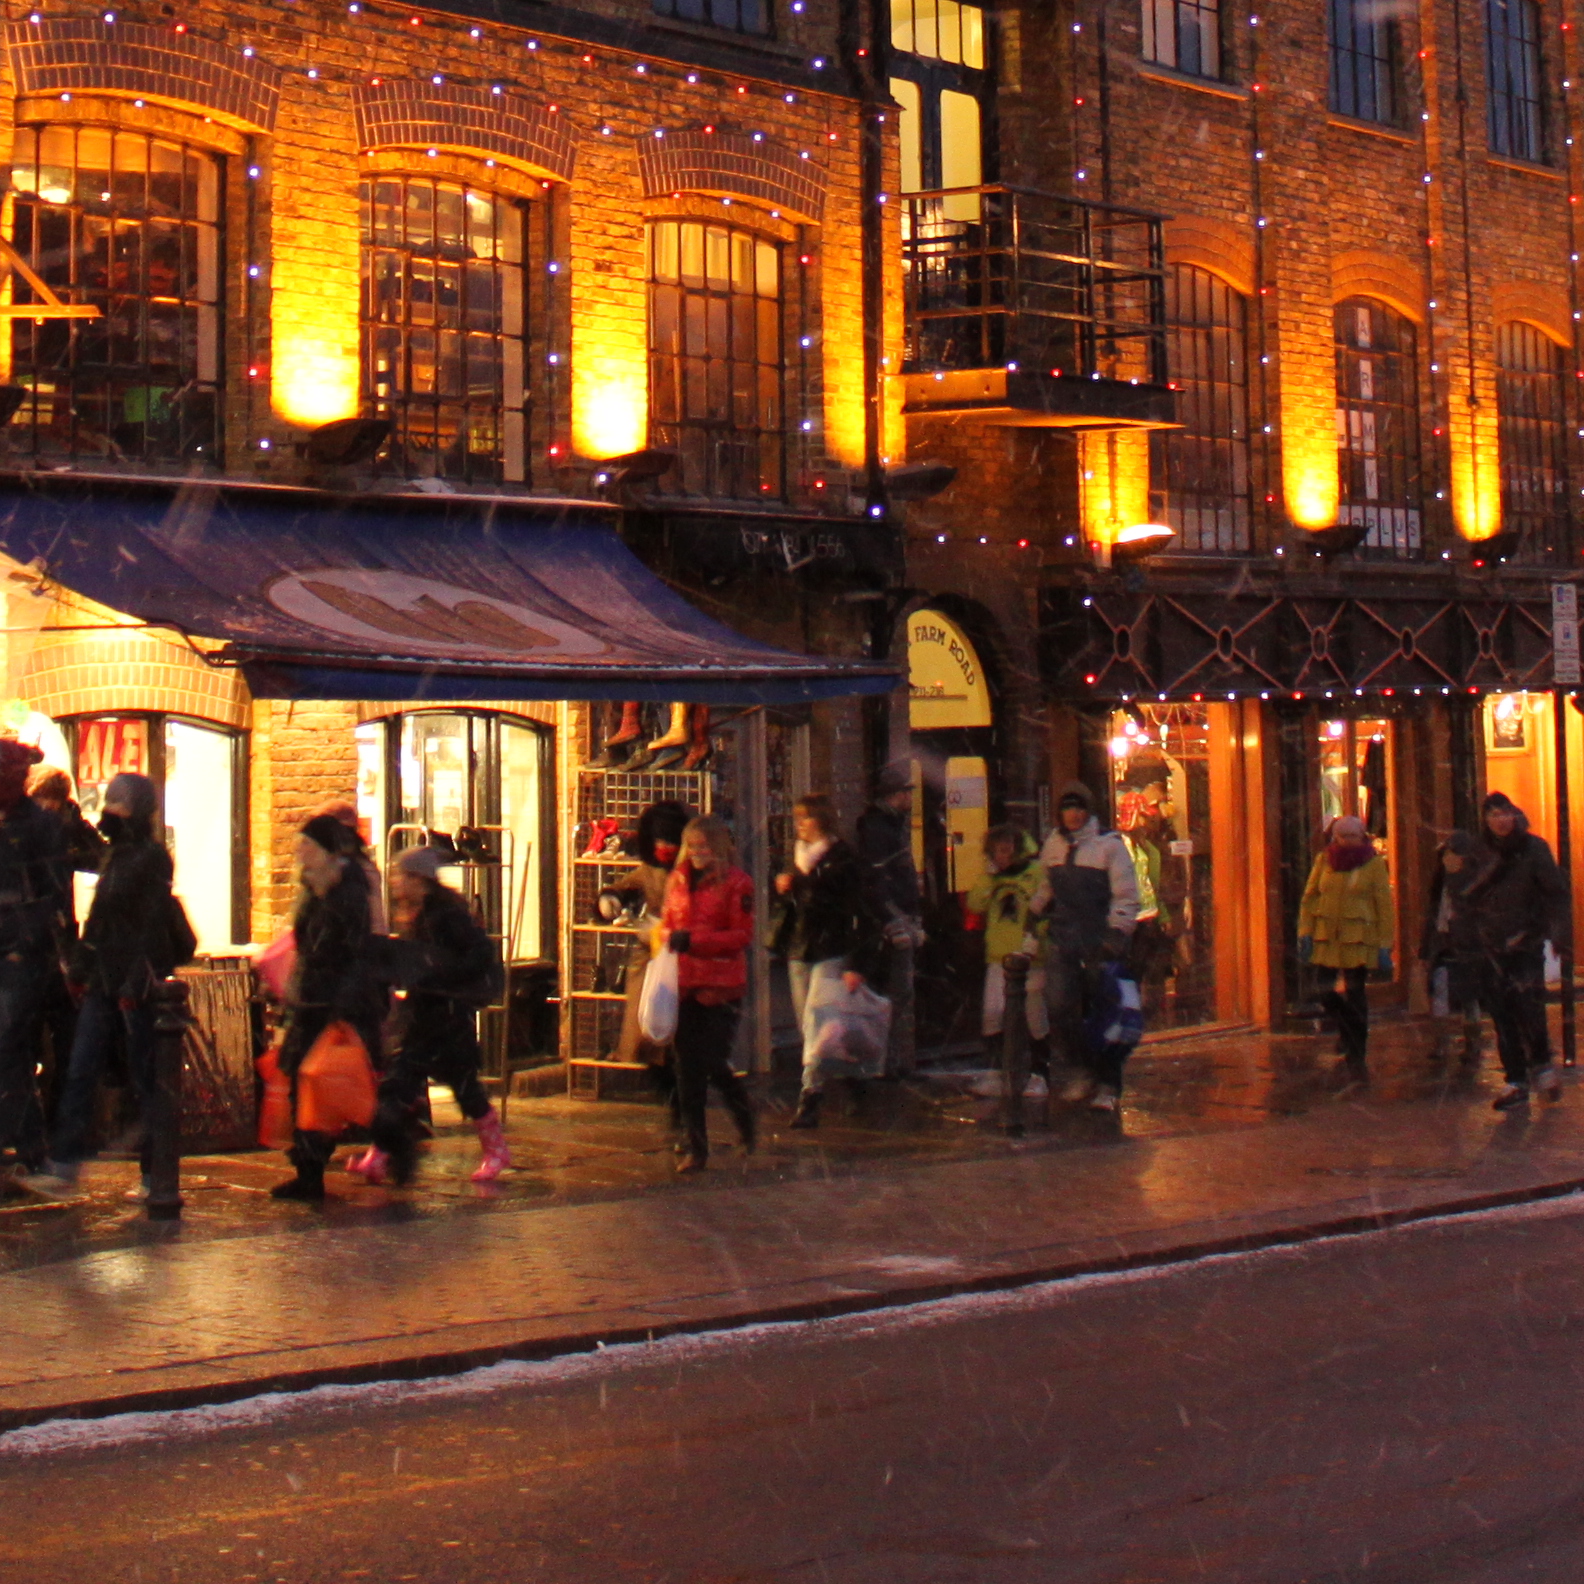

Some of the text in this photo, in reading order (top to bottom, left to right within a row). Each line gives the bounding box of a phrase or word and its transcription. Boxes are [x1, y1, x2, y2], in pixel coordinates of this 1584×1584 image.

[914, 625, 975, 686] FARM ROAD
[78, 723, 139, 779] ALE
